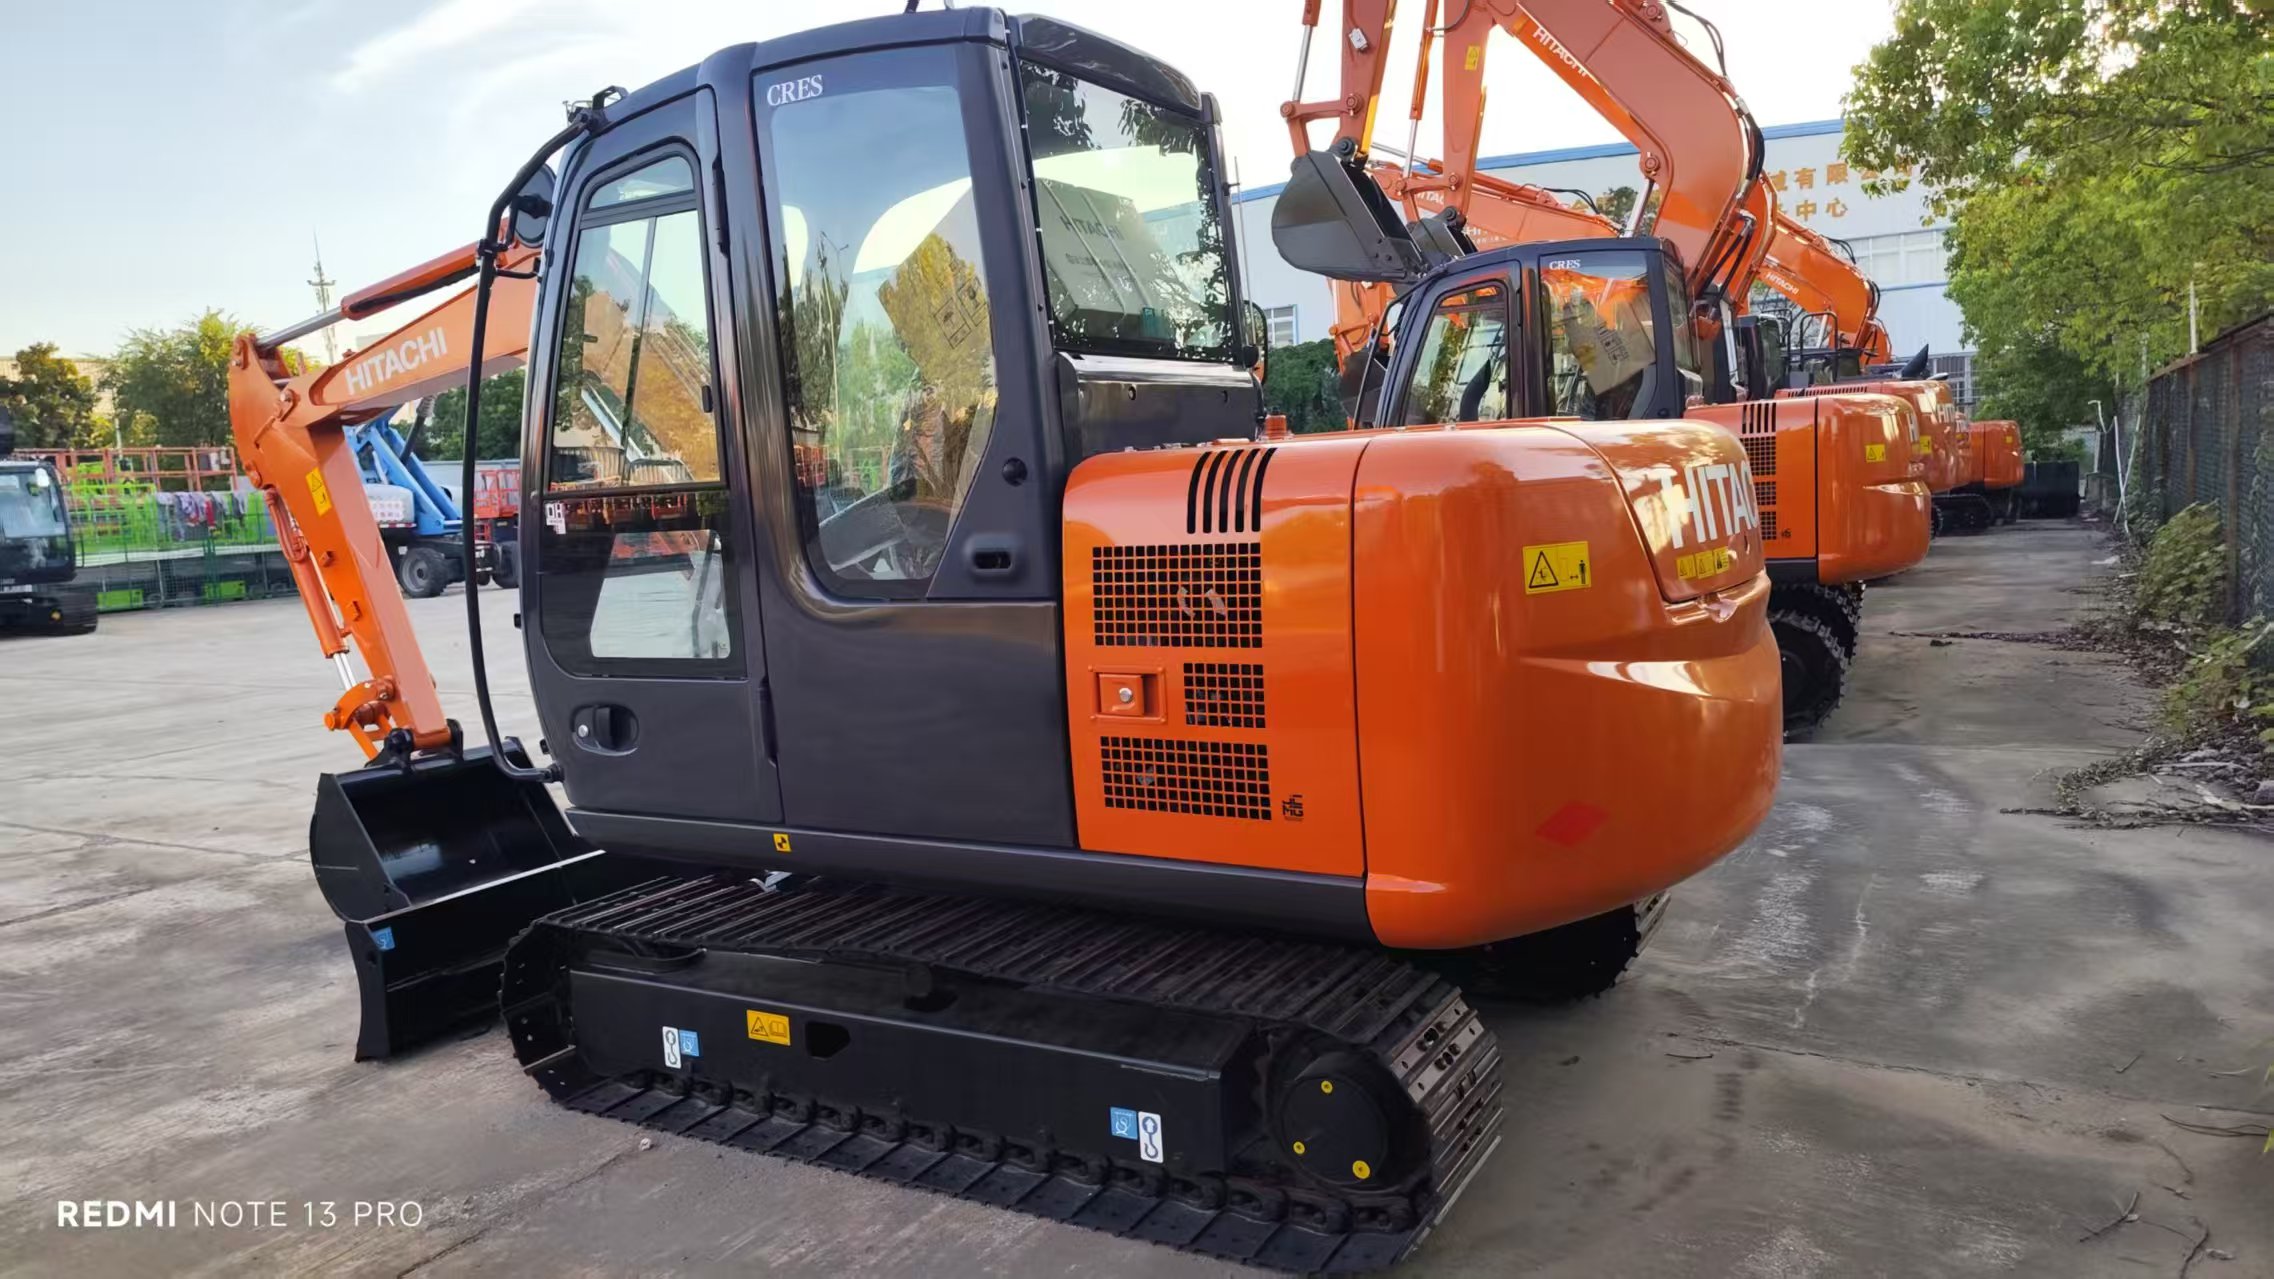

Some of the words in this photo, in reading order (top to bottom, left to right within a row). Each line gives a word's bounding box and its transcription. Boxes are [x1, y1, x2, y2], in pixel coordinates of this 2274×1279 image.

[767, 74, 824, 106] CRES
[1549, 259, 1581, 270] CRES
[345, 326, 448, 396] HITACHI
